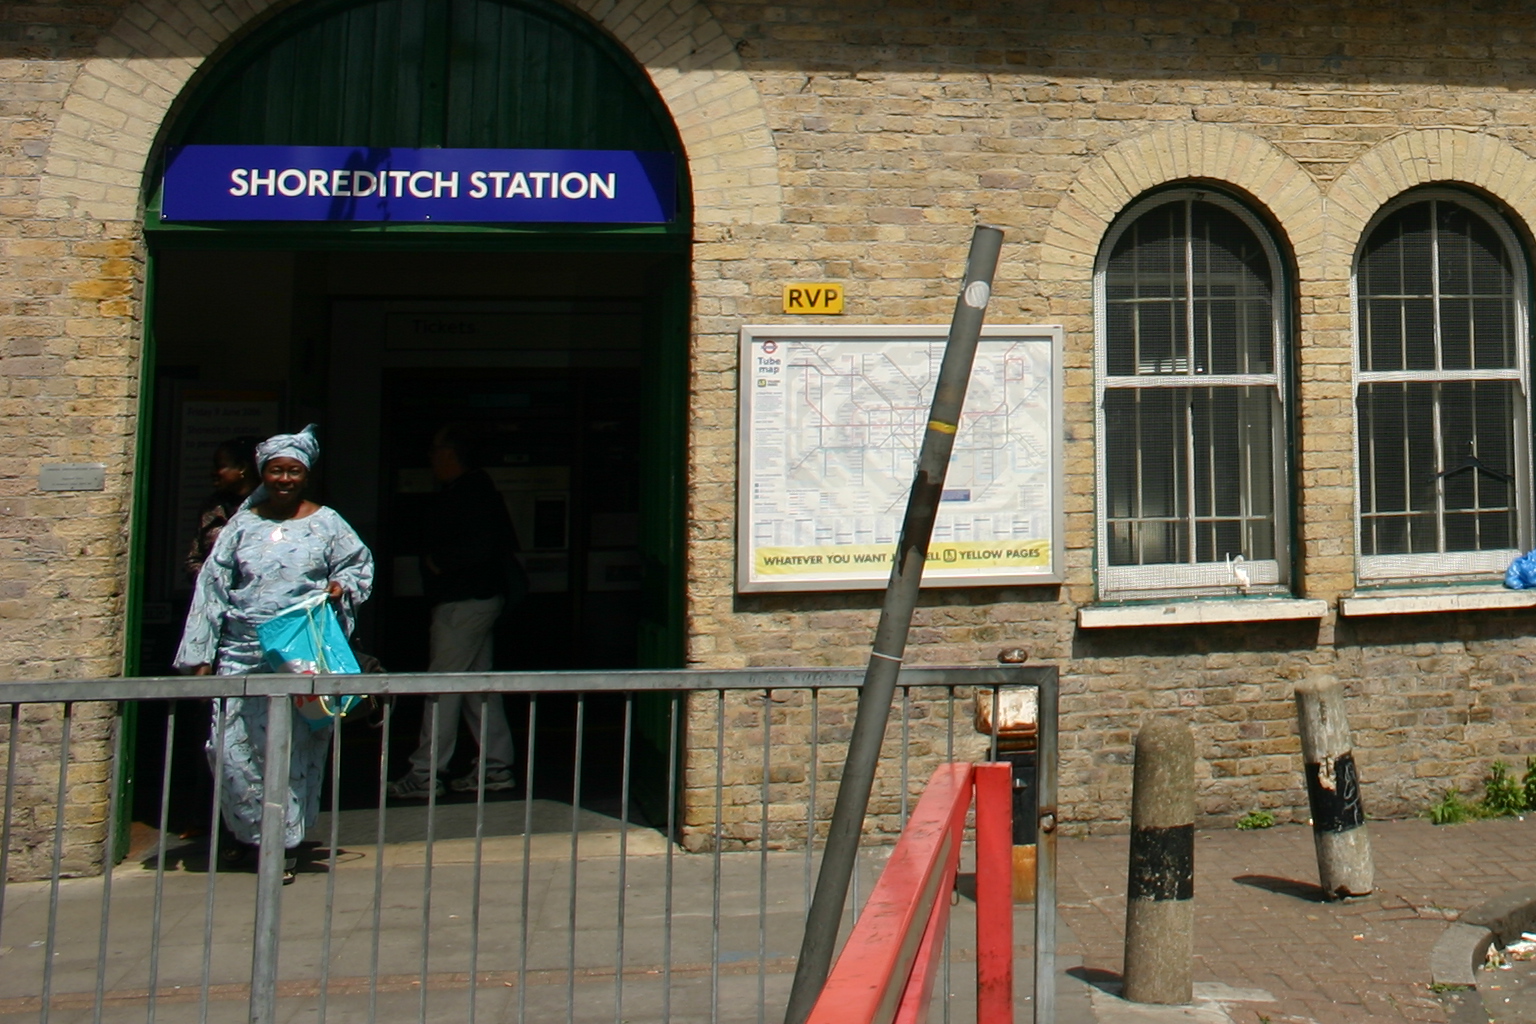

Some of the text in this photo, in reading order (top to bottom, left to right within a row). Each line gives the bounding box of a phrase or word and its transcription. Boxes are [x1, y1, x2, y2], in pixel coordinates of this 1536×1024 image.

[229, 168, 616, 199] SHOREDITCH STATION
[789, 289, 838, 308] RVP
[412, 319, 476, 334] Tickets
[757, 357, 781, 365] Tube
[759, 366, 780, 375] map
[764, 555, 823, 566] WHATEVER
[827, 554, 850, 564] YOU
[854, 553, 887, 563] WANT
[959, 549, 1003, 560] YELLOW
[1005, 548, 1041, 559] PAGES
